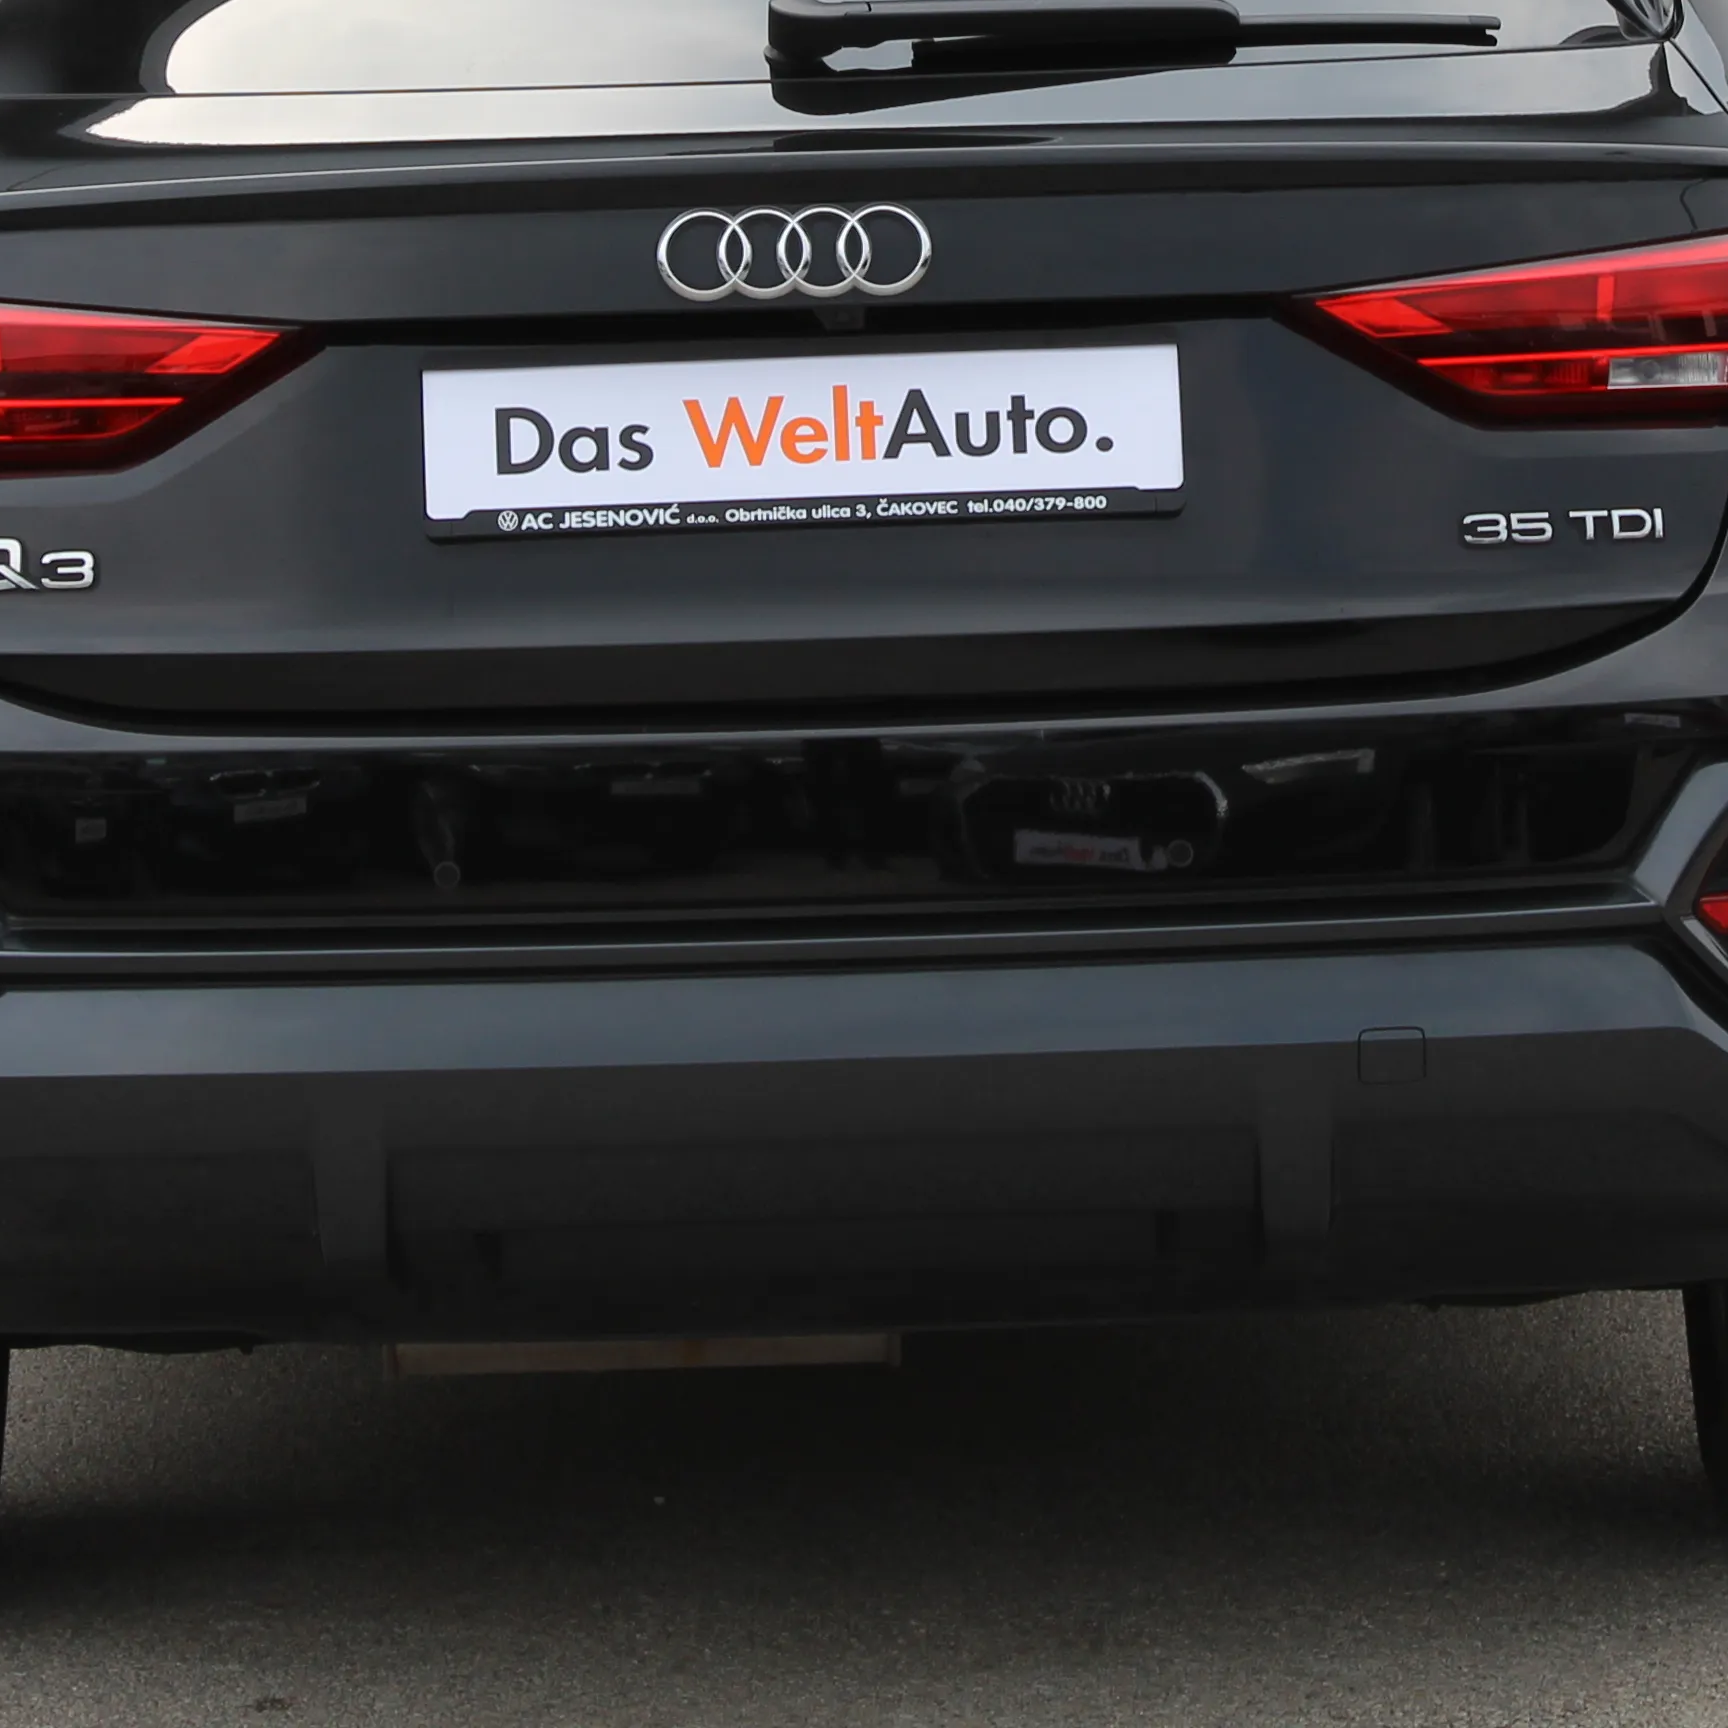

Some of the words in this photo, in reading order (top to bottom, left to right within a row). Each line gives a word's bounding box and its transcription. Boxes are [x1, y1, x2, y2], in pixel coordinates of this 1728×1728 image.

[494, 406, 654, 476] Das
[682, 384, 1114, 469] WeltAuto.
[521, 512, 554, 531] AC
[559, 503, 681, 530] JESENOVIĆ
[686, 513, 720, 524] d.o.o.
[725, 504, 807, 523] Obrtnička
[811, 504, 851, 520] ulica
[855, 503, 872, 520] 3,
[876, 498, 959, 517] ČAKOVEC
[1462, 511, 1553, 545] 35
[1569, 507, 1665, 540] TDI
